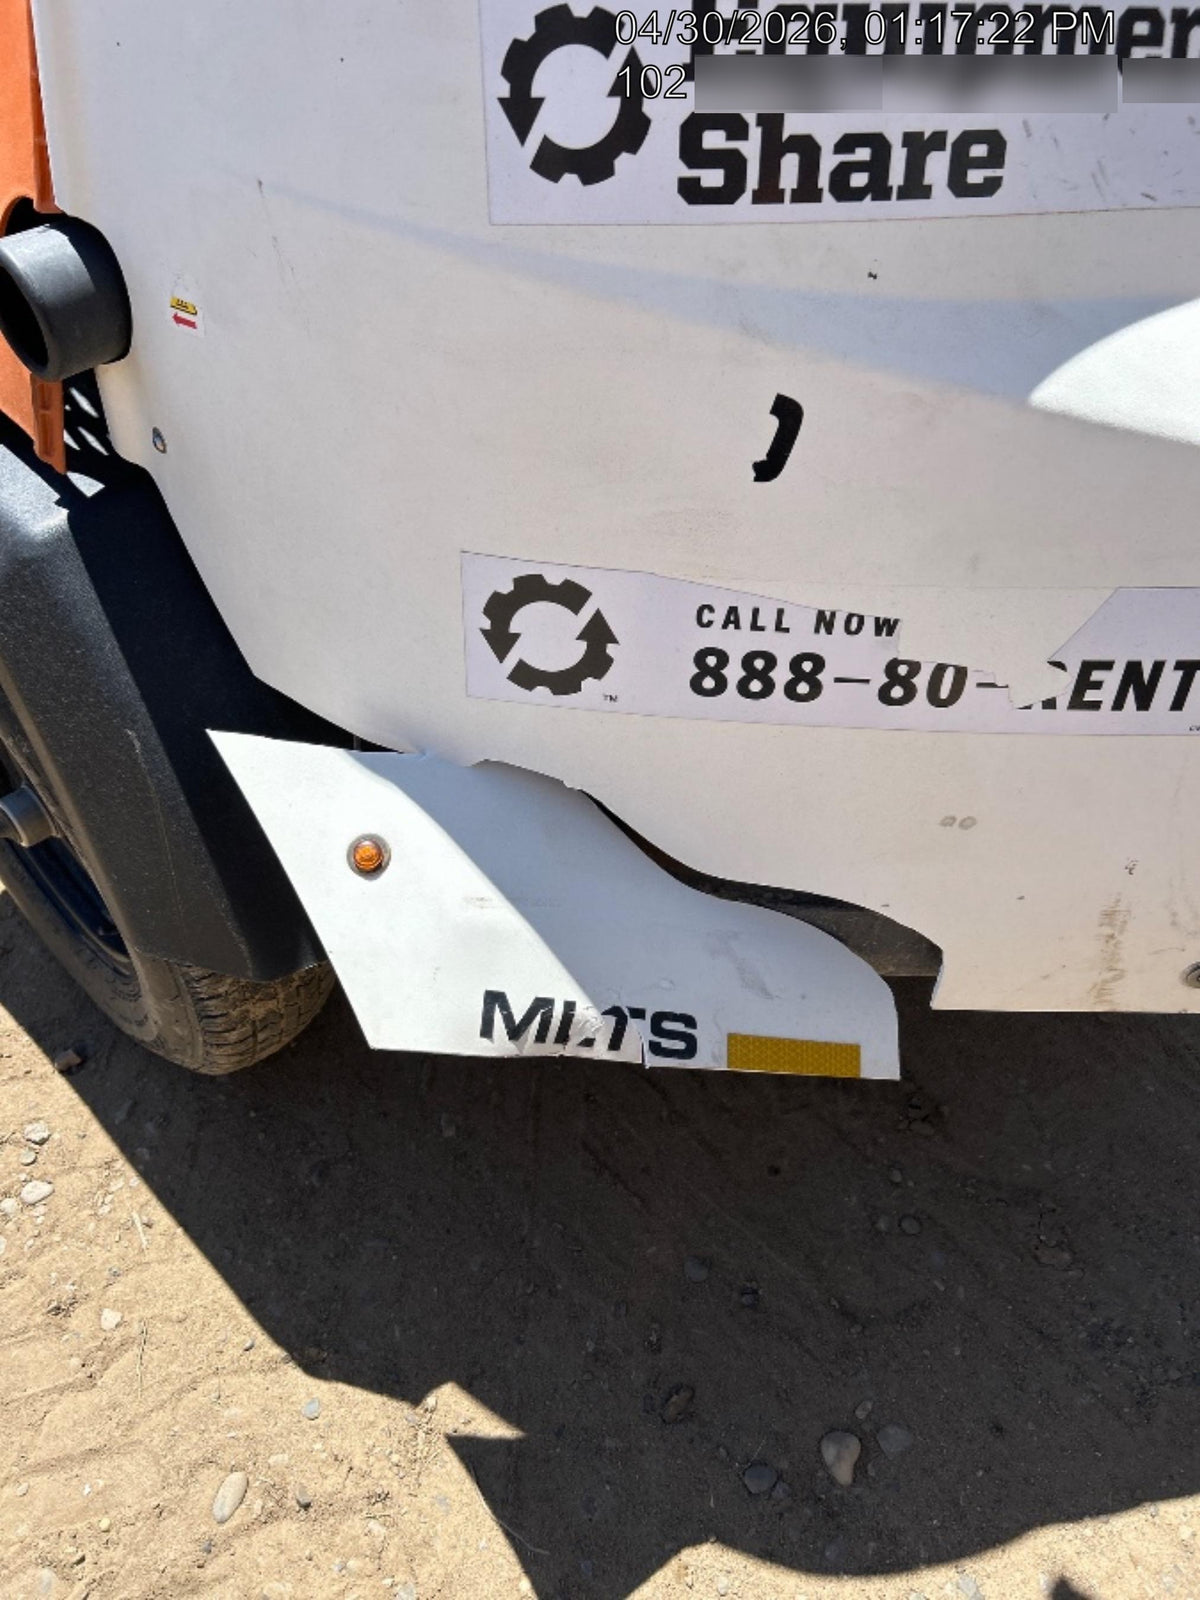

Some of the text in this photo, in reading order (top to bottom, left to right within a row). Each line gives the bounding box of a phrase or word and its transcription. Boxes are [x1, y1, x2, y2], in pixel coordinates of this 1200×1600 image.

[677, 112, 1007, 205] Share
[695, 604, 900, 637] CALL NOW
[689, 646, 1200, 711] 888-80-ENT
